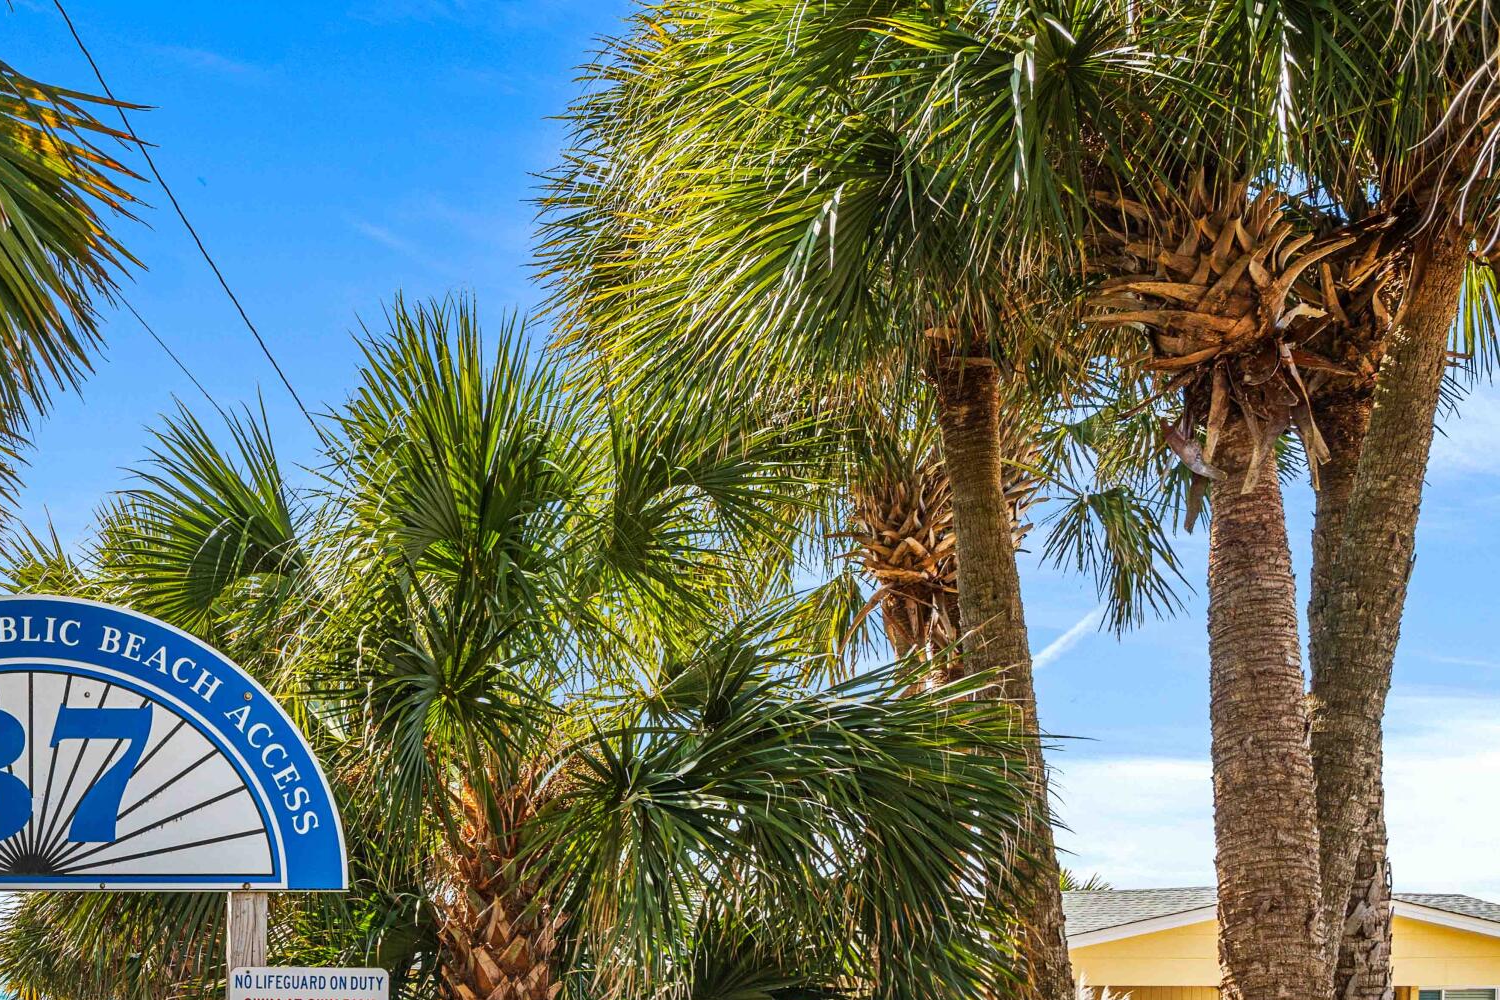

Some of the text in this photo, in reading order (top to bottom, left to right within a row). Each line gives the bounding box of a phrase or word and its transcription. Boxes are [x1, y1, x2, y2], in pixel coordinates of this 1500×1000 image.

[100, 625, 224, 702] BEACH
[224, 705, 319, 836] ACCESS
[235, 975, 384, 991] NO LIFEGUARD ON DUTY
